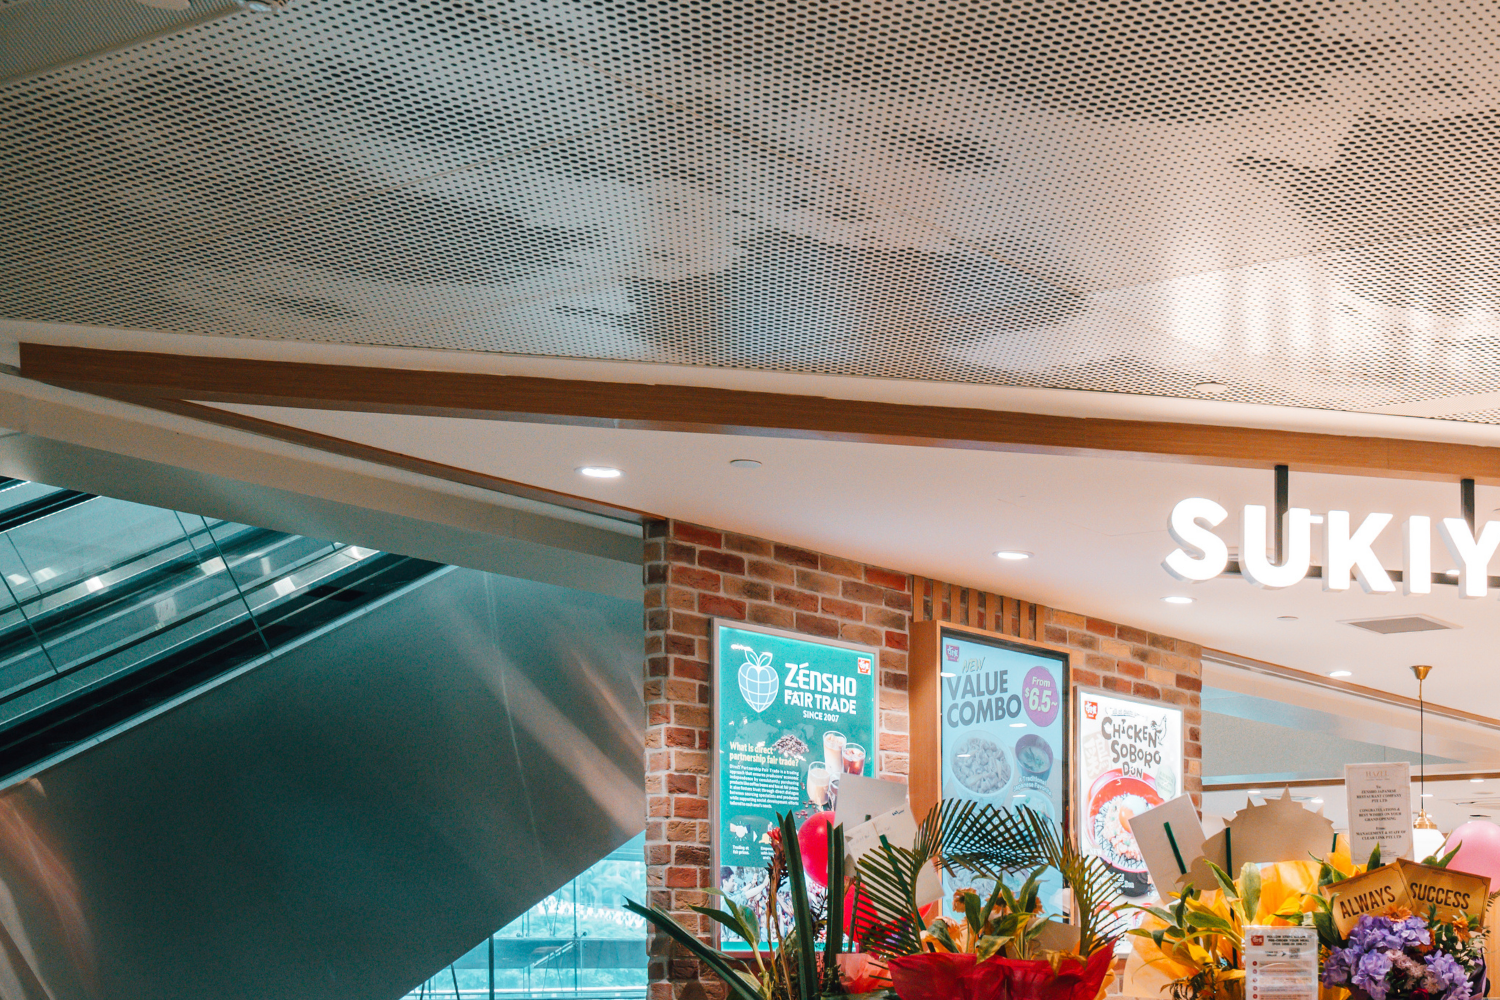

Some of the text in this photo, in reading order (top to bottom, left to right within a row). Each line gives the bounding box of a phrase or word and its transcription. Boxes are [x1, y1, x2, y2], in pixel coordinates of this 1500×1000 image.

[962, 657, 985, 673] NEW
[946, 670, 1008, 700] VALUE
[1032, 676, 1050, 687] From
[785, 690, 856, 714] FAIR TRADE
[947, 694, 1021, 728] COMBO
[803, 710, 839, 722] SINCE 2007
[1101, 717, 1157, 748] CHICKEN
[730, 742, 747, 751] What
[1111, 740, 1161, 768] SOBORO
[730, 753, 799, 766] partnership fair trade?
[1340, 882, 1470, 919] ALWAYS SUCCESS
